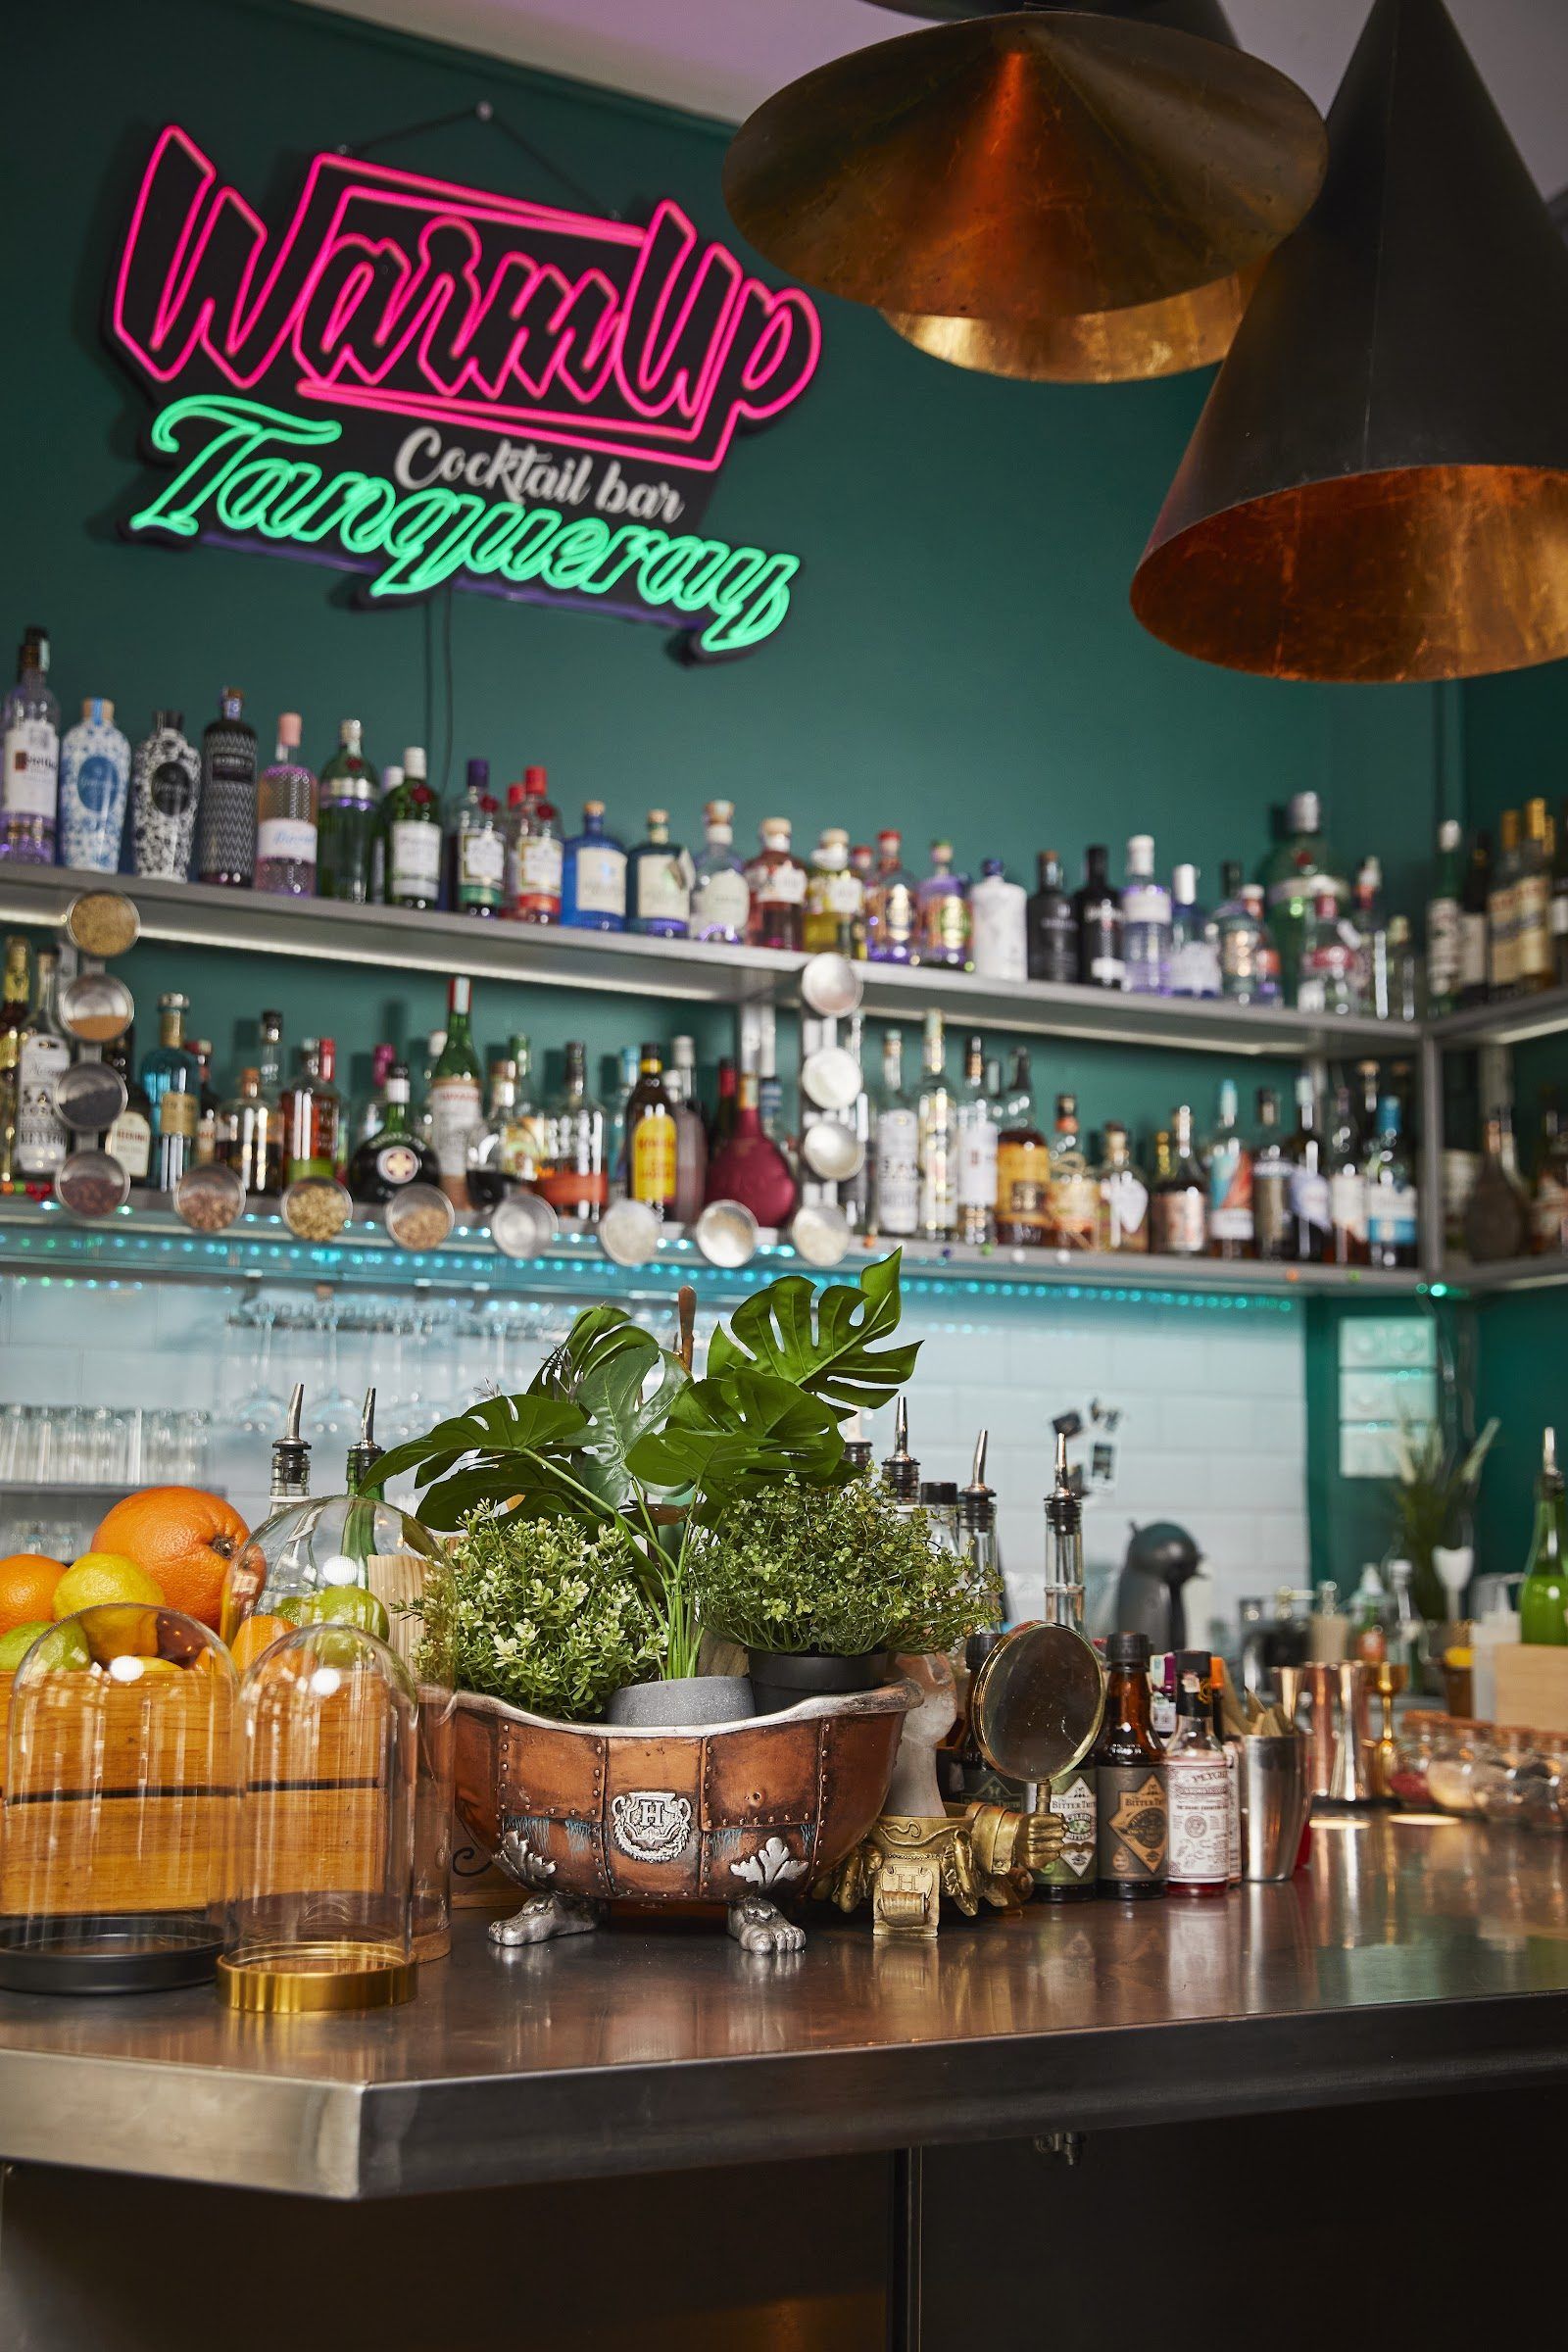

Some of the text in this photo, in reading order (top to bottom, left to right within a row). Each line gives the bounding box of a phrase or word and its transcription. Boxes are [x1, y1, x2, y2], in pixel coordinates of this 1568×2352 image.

[394, 426, 685, 523] Cocktail bar
[130, 395, 801, 652] Tanqueray
[640, 1801, 663, 1826] H
[896, 1873, 919, 1891] H
